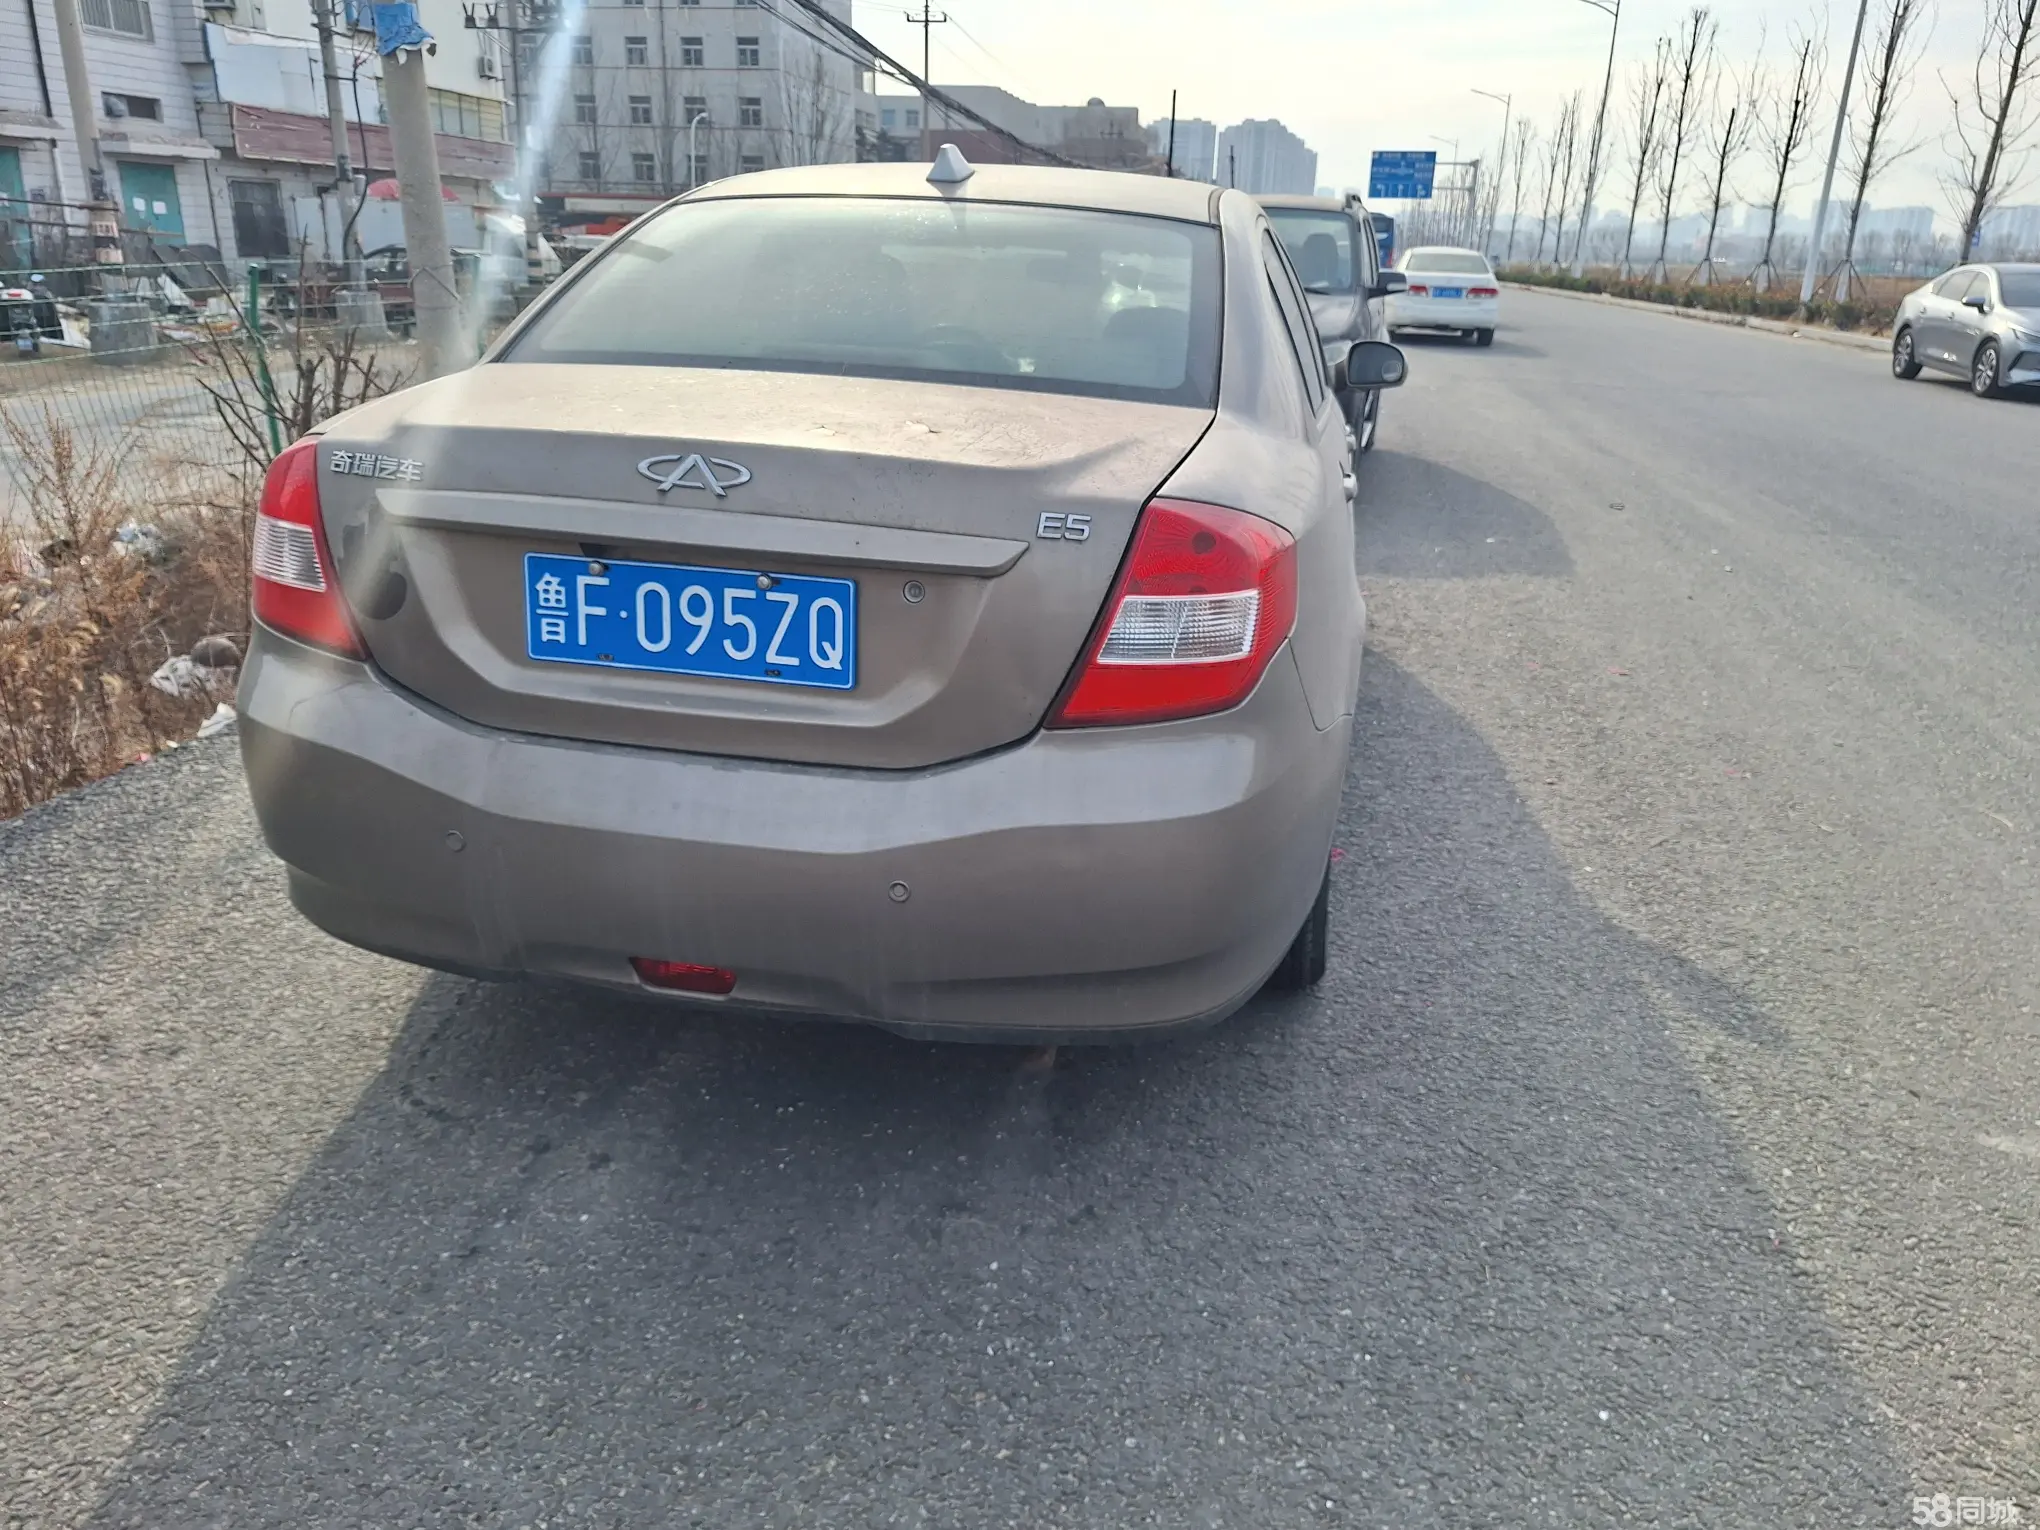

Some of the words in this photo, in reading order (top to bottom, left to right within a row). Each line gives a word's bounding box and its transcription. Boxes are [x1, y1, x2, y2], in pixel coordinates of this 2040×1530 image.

[330, 450, 423, 481] 奇瑞汽车
[1036, 511, 1092, 541] E5
[535, 573, 843, 670] 鲁F·095ZQ
